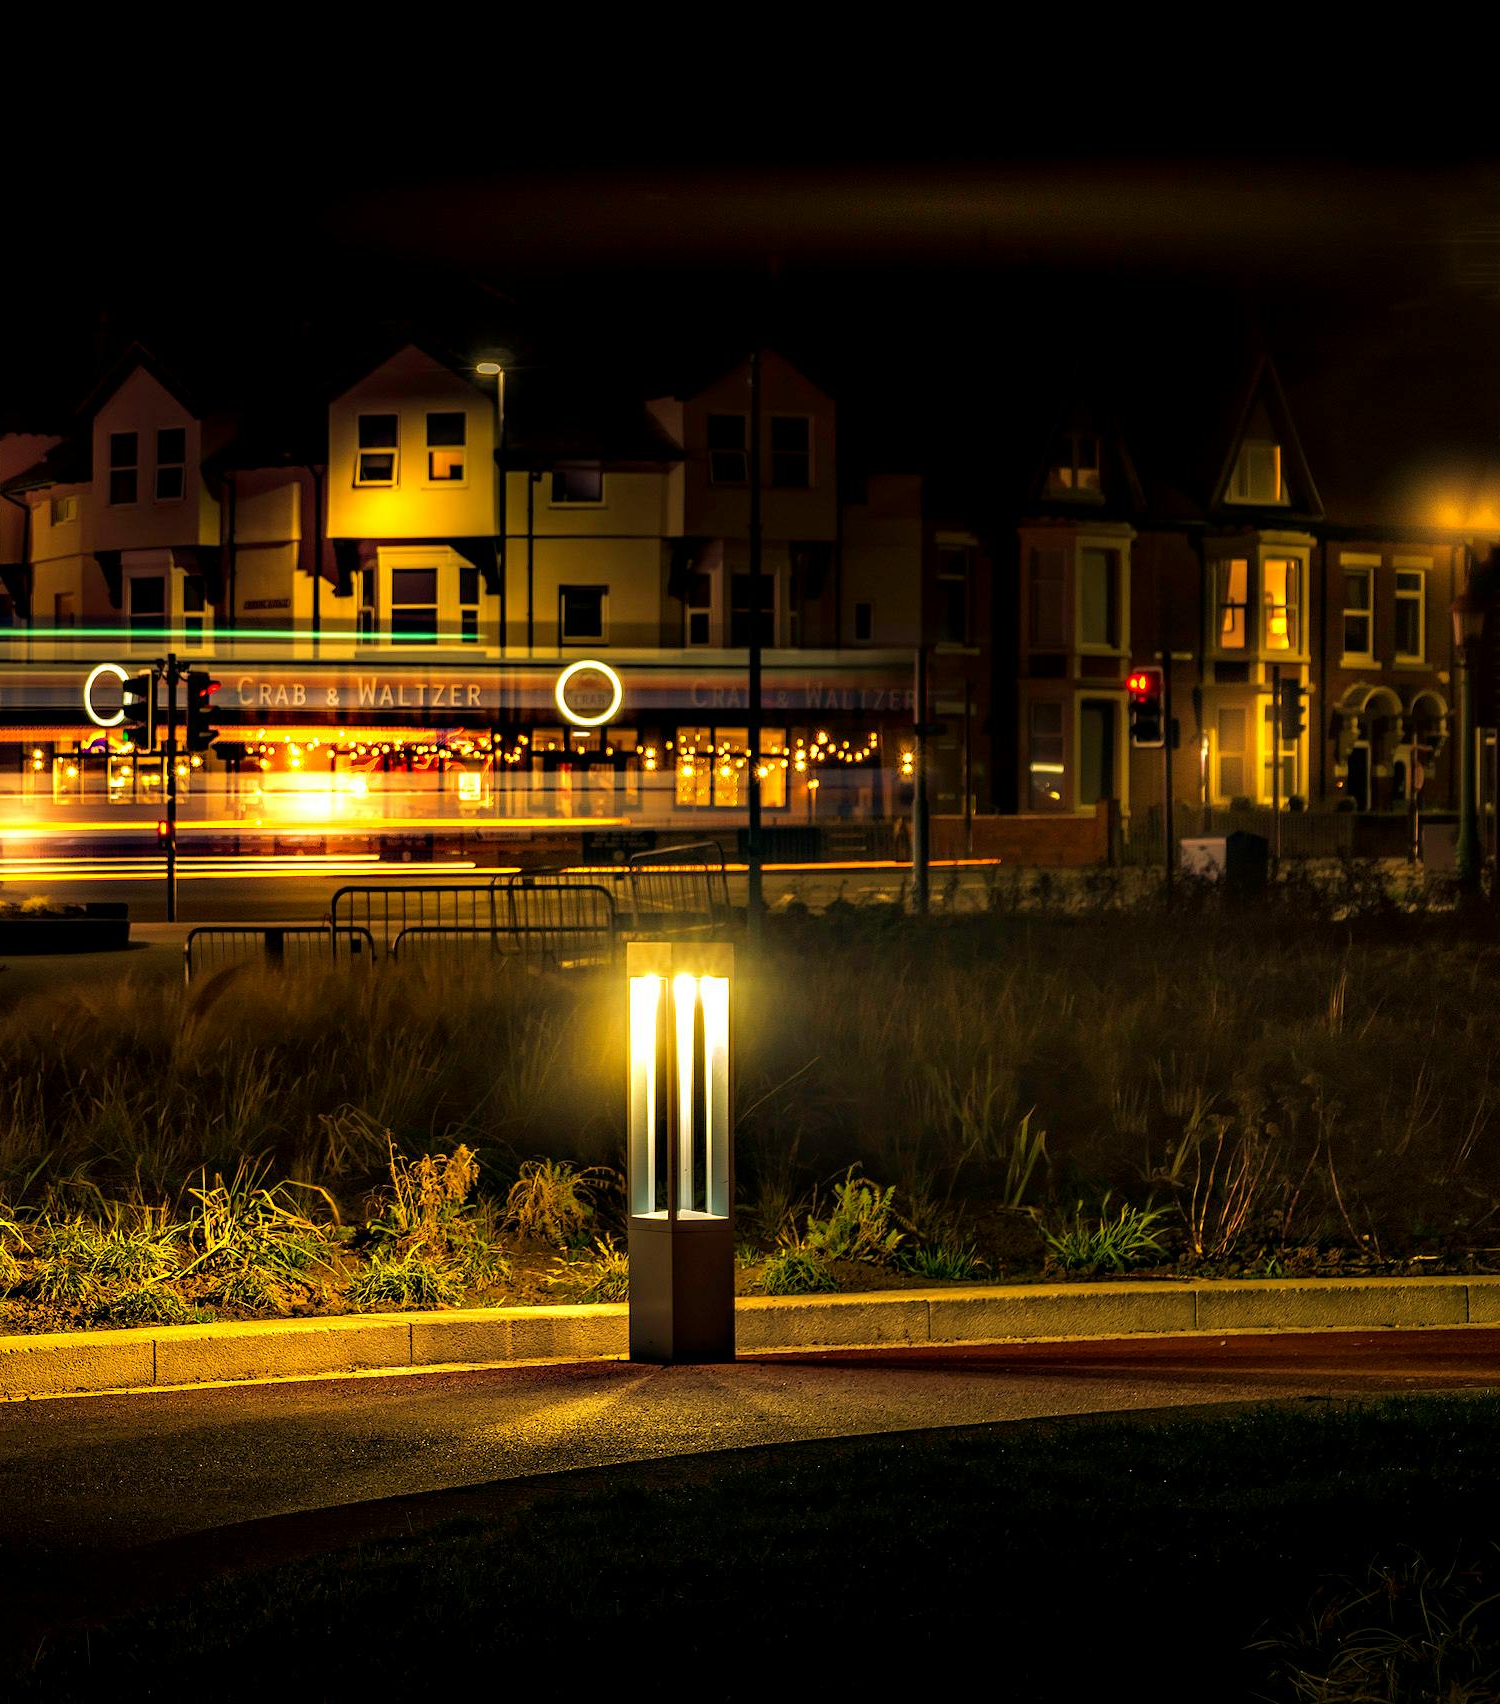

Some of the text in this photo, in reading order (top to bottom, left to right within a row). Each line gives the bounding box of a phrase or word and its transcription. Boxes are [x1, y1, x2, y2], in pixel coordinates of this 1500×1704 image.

[237, 677, 483, 706] CRAB & WALTZER
